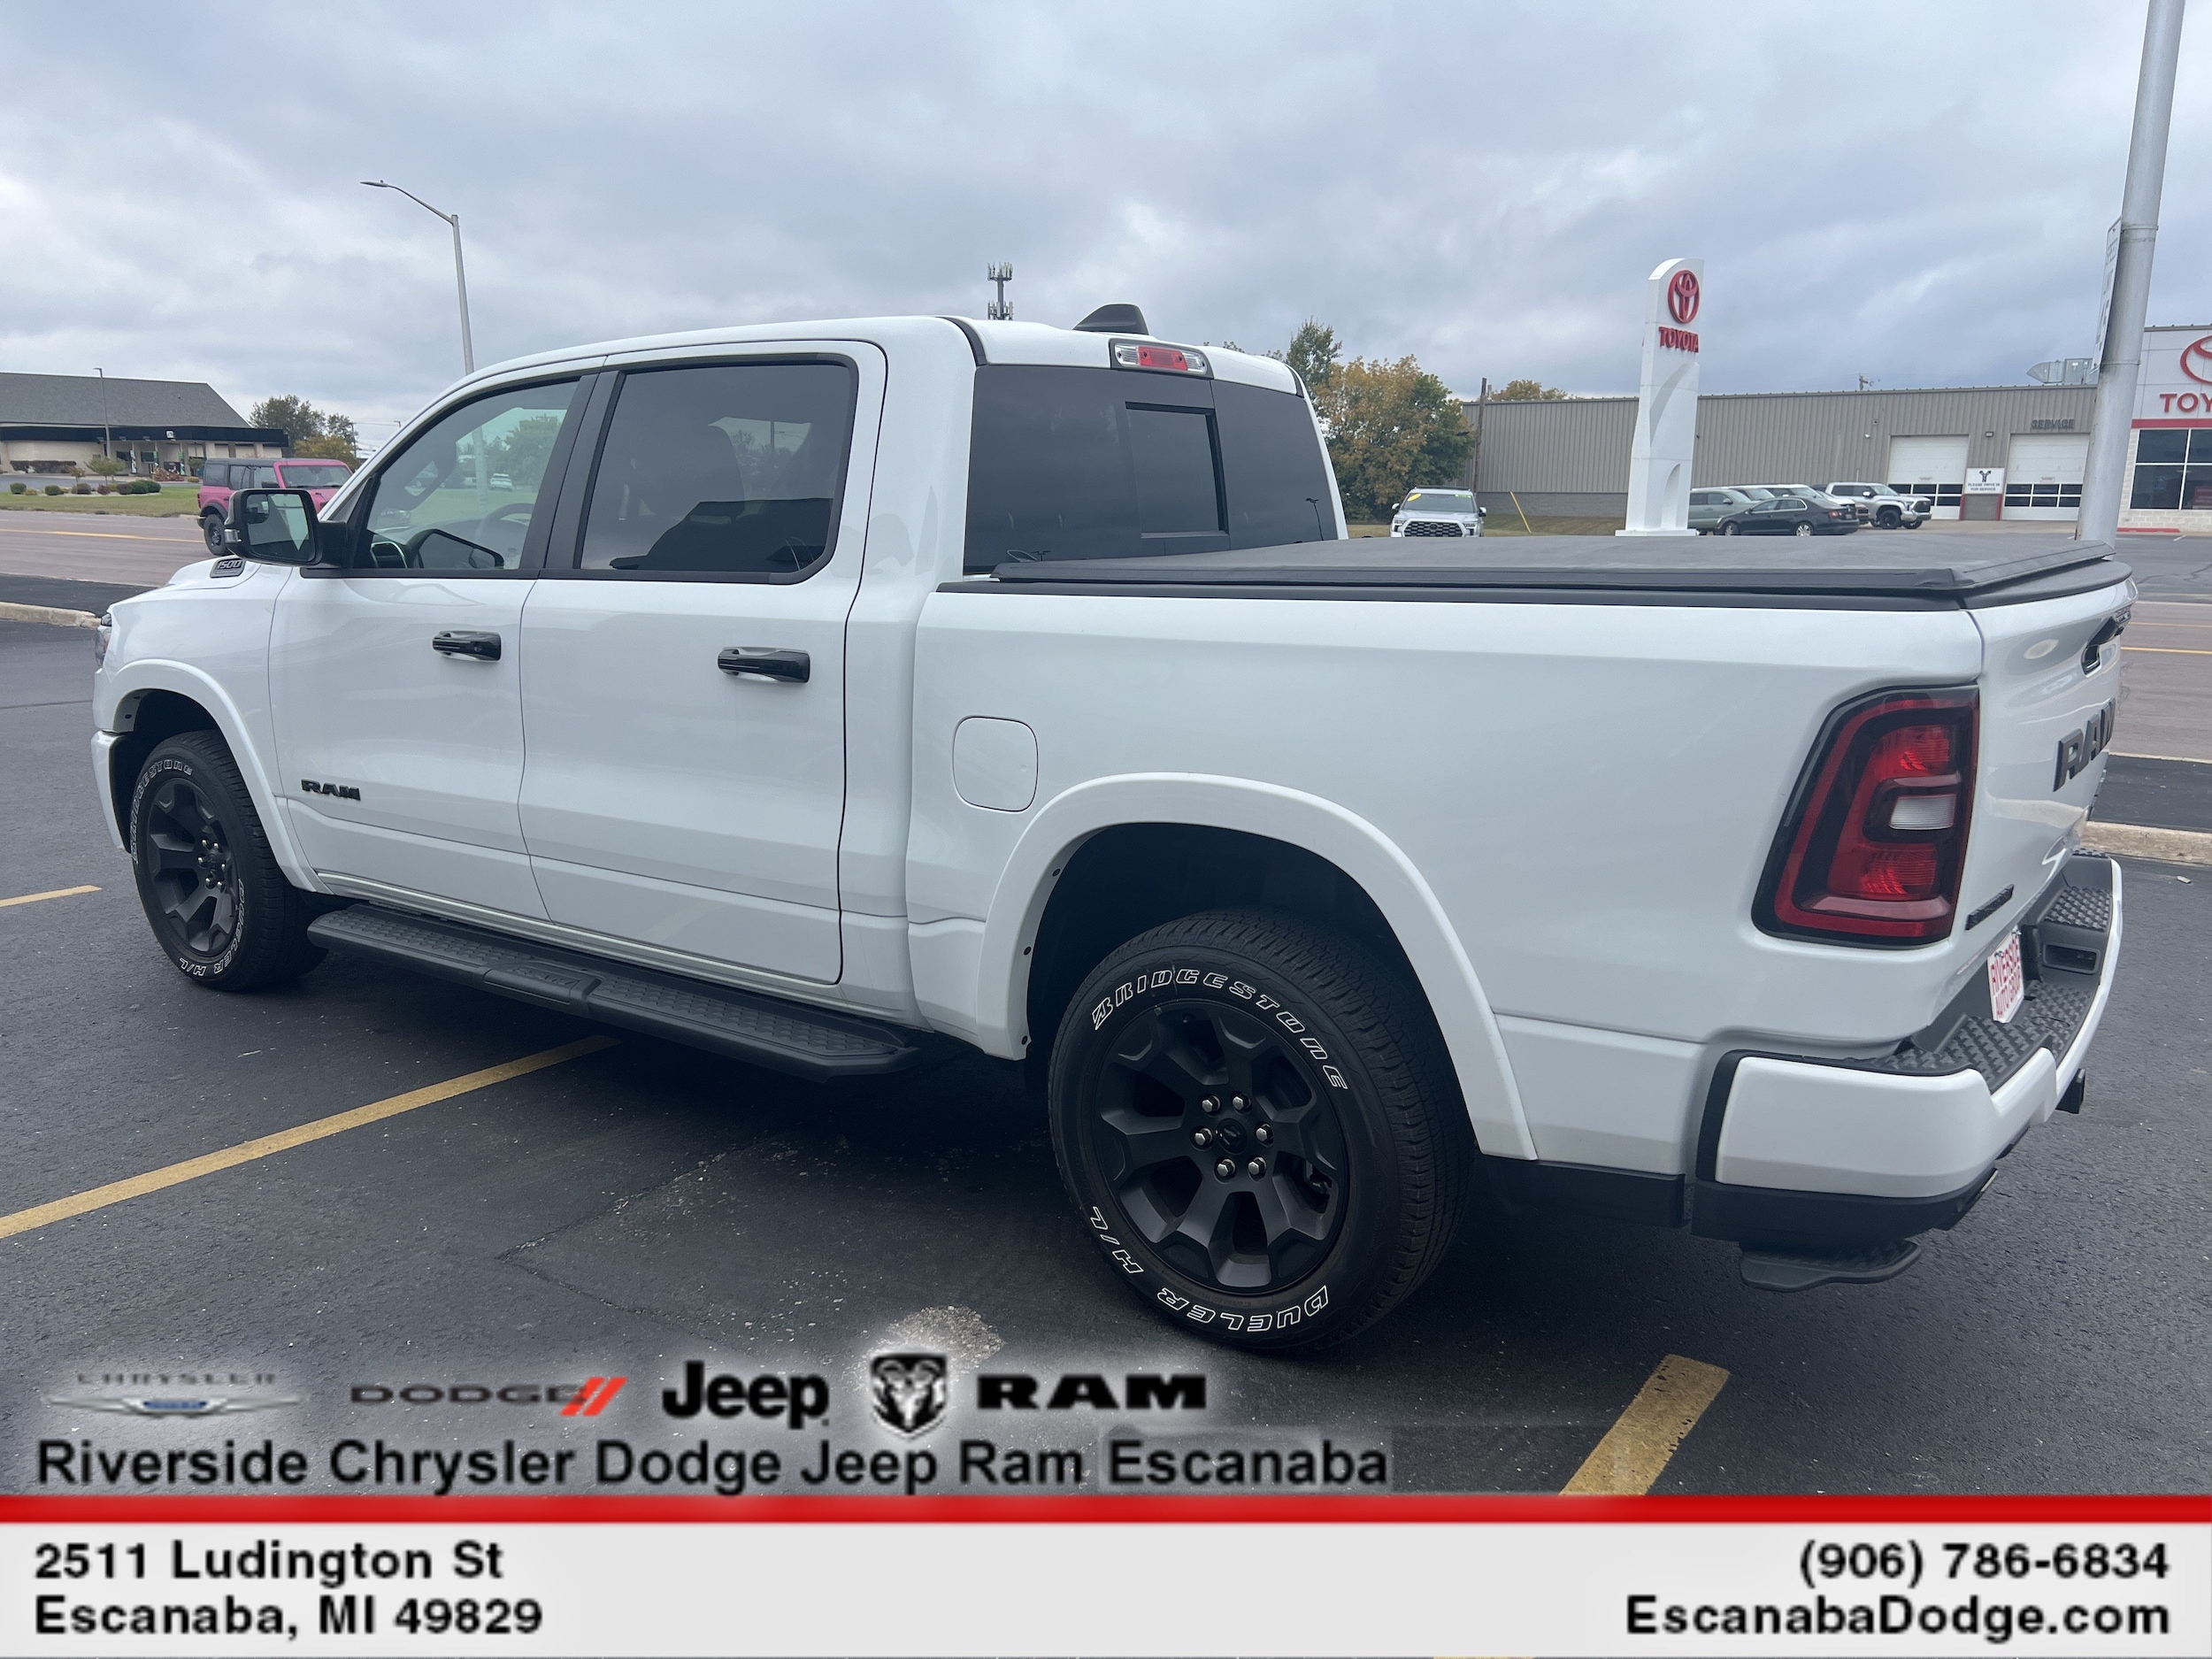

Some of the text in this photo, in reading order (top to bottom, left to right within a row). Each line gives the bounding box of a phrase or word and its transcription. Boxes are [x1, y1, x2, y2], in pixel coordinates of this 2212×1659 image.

[1658, 326, 1699, 353] TOYOTA
[2032, 419, 2075, 429] SERVICE
[217, 559, 243, 569] 1500
[130, 759, 193, 864] BRIDGESTONE
[301, 779, 361, 801] RAM
[179, 879, 245, 977] DUELER H/L
[1991, 934, 2021, 995] RIVERSIDE
[1091, 968, 1348, 1091] BRIDGESTONE
[1090, 1205, 1330, 1333] DUELER H/L
